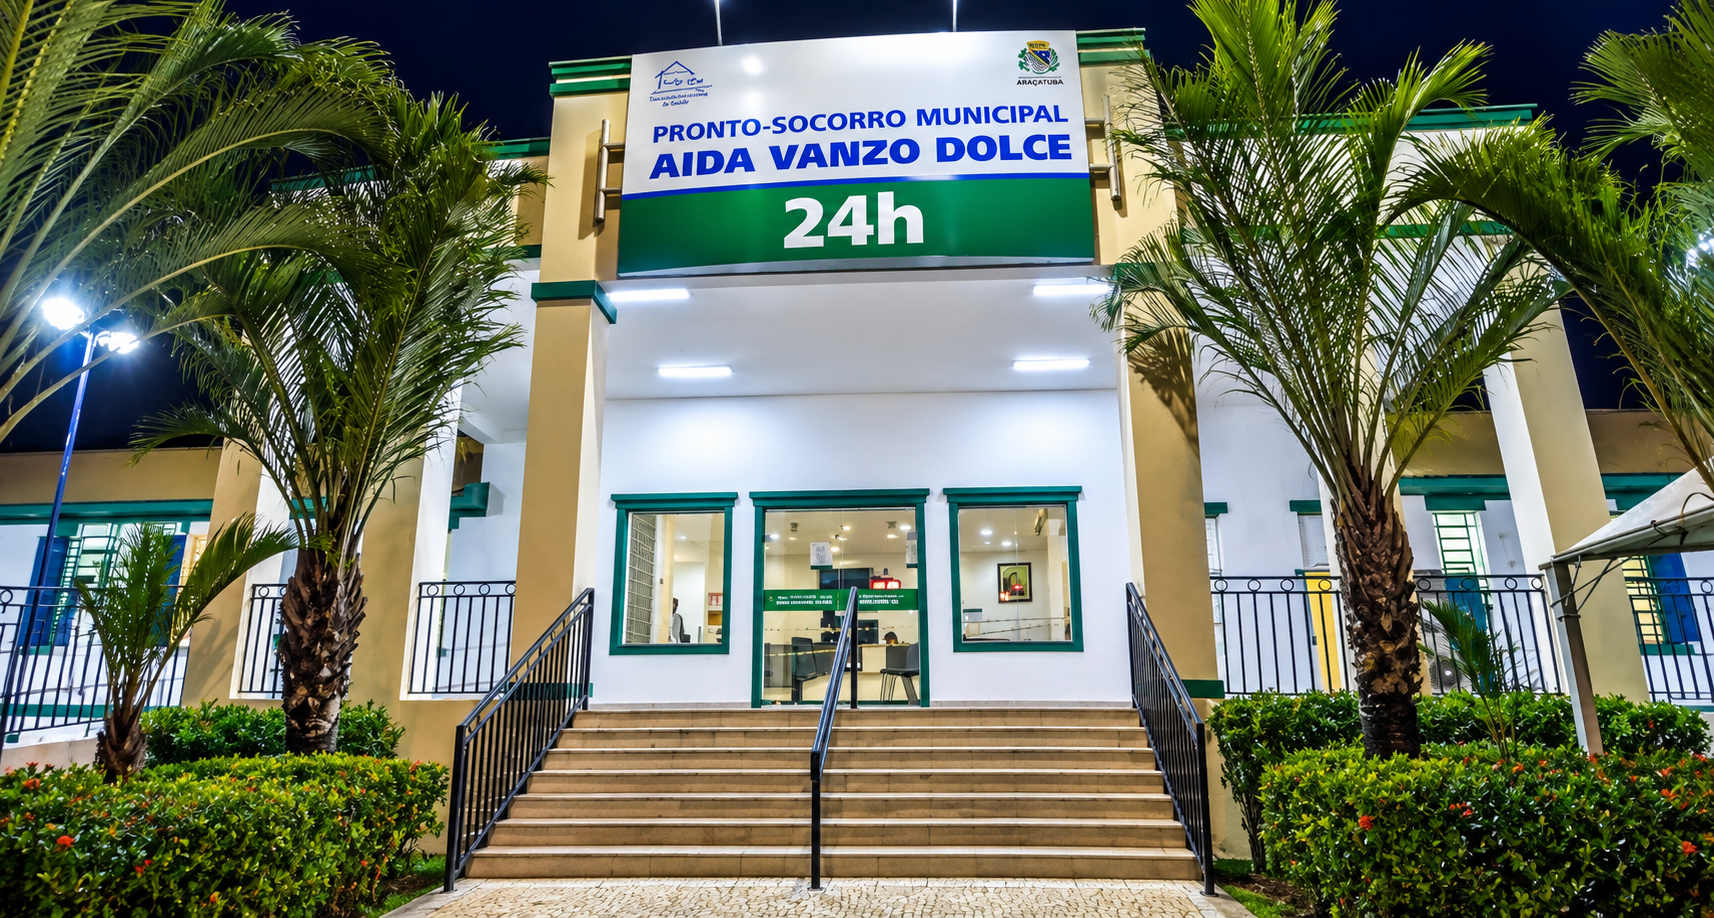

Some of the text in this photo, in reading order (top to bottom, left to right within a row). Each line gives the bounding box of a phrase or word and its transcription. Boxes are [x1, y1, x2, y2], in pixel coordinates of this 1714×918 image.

[1017, 79, 1064, 87] ARAÇATUBA
[652, 104, 1069, 144] PRONTO-SOCORRO MUNICIPAL
[649, 133, 1073, 180] AIDA VANZO DOLCE
[783, 190, 925, 249] 24h
